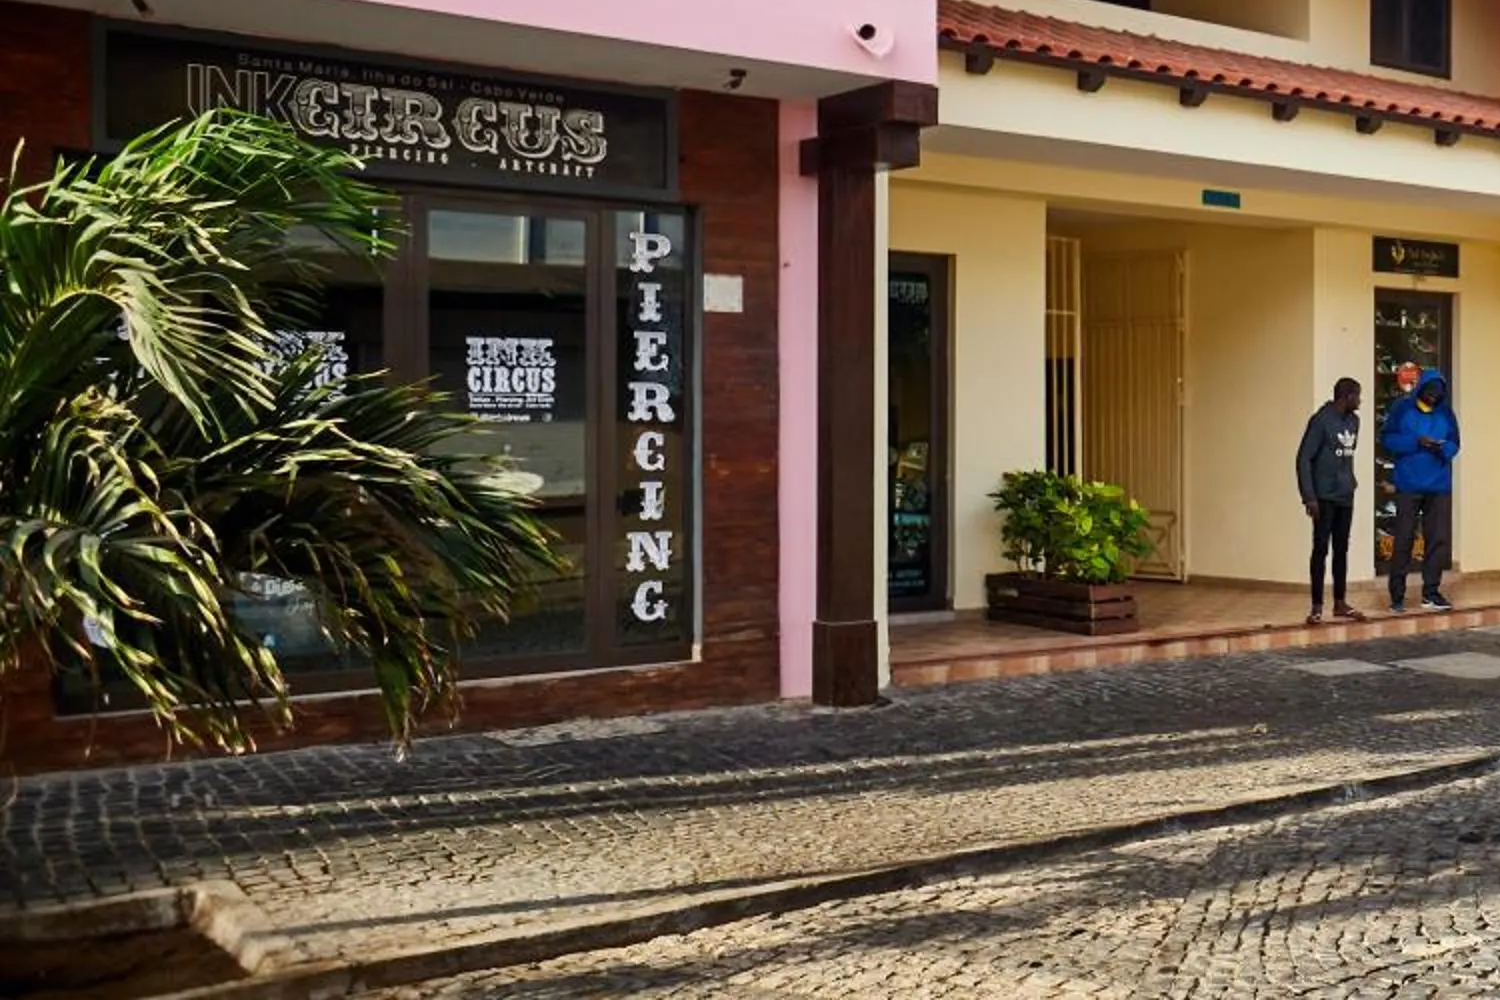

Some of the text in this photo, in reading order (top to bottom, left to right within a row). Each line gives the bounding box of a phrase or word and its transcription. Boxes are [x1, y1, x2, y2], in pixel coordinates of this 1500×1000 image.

[238, 53, 293, 71] Santa
[400, 75, 422, 87] do
[427, 76, 453, 90] Sal
[470, 81, 513, 97] Cabo
[517, 89, 565, 104] Verde
[351, 143, 449, 165] PIERCING
[466, 337, 557, 367] INK
[467, 366, 556, 393] CIRCUS
[626, 231, 676, 622] PIERCING
